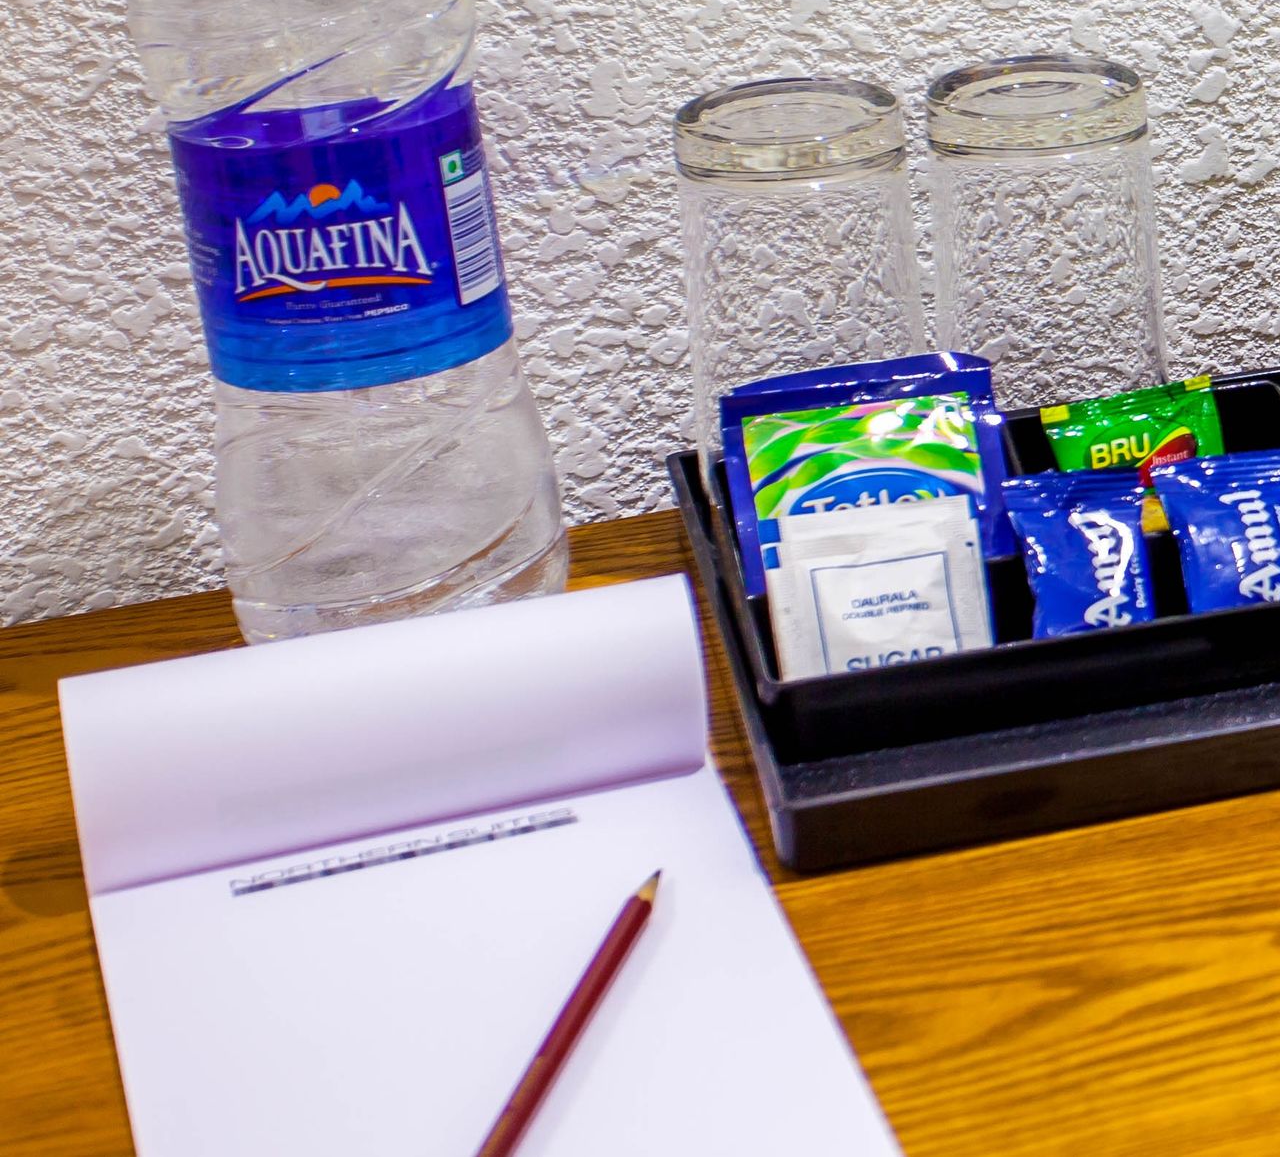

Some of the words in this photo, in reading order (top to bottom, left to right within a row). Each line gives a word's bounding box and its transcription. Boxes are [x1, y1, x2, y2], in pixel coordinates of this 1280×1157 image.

[234, 201, 434, 295] AQUAFINA
[1090, 432, 1151, 470] BRU
[1151, 449, 1189, 466] Instant
